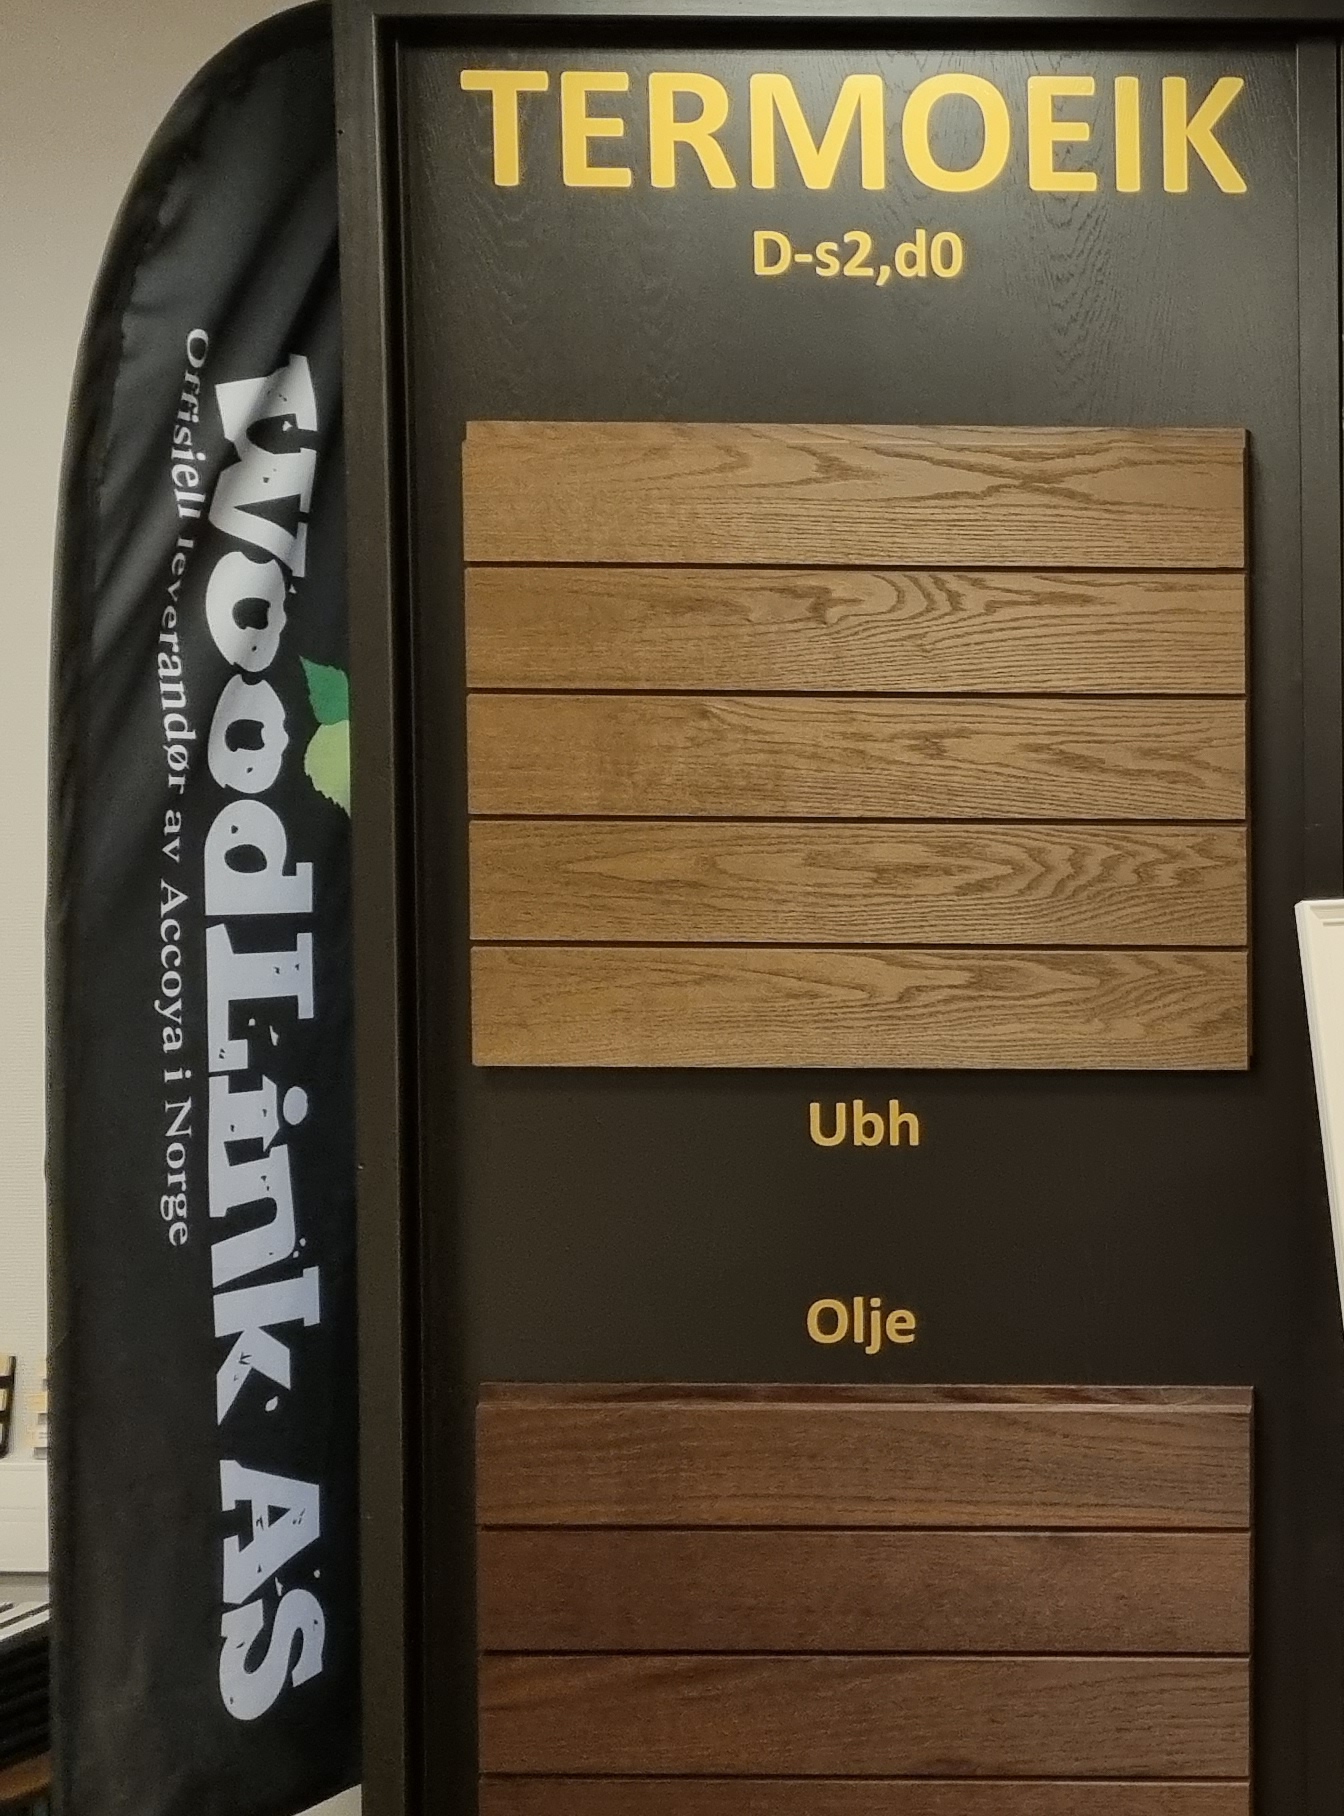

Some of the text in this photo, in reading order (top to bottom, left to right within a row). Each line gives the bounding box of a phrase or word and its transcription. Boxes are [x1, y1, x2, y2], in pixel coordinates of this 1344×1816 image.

[459, 69, 1247, 195] TERMOEIK
[754, 228, 965, 284] D-s2,d0
[157, 536, 197, 795] leverandør
[161, 809, 183, 863] av
[154, 878, 189, 1053] Accoya
[163, 1068, 192, 1083] i
[204, 353, 327, 1720] WoodLink AS
[810, 1100, 919, 1146] Ubh
[159, 1097, 193, 1247] Norge
[807, 1296, 916, 1354] Olje
